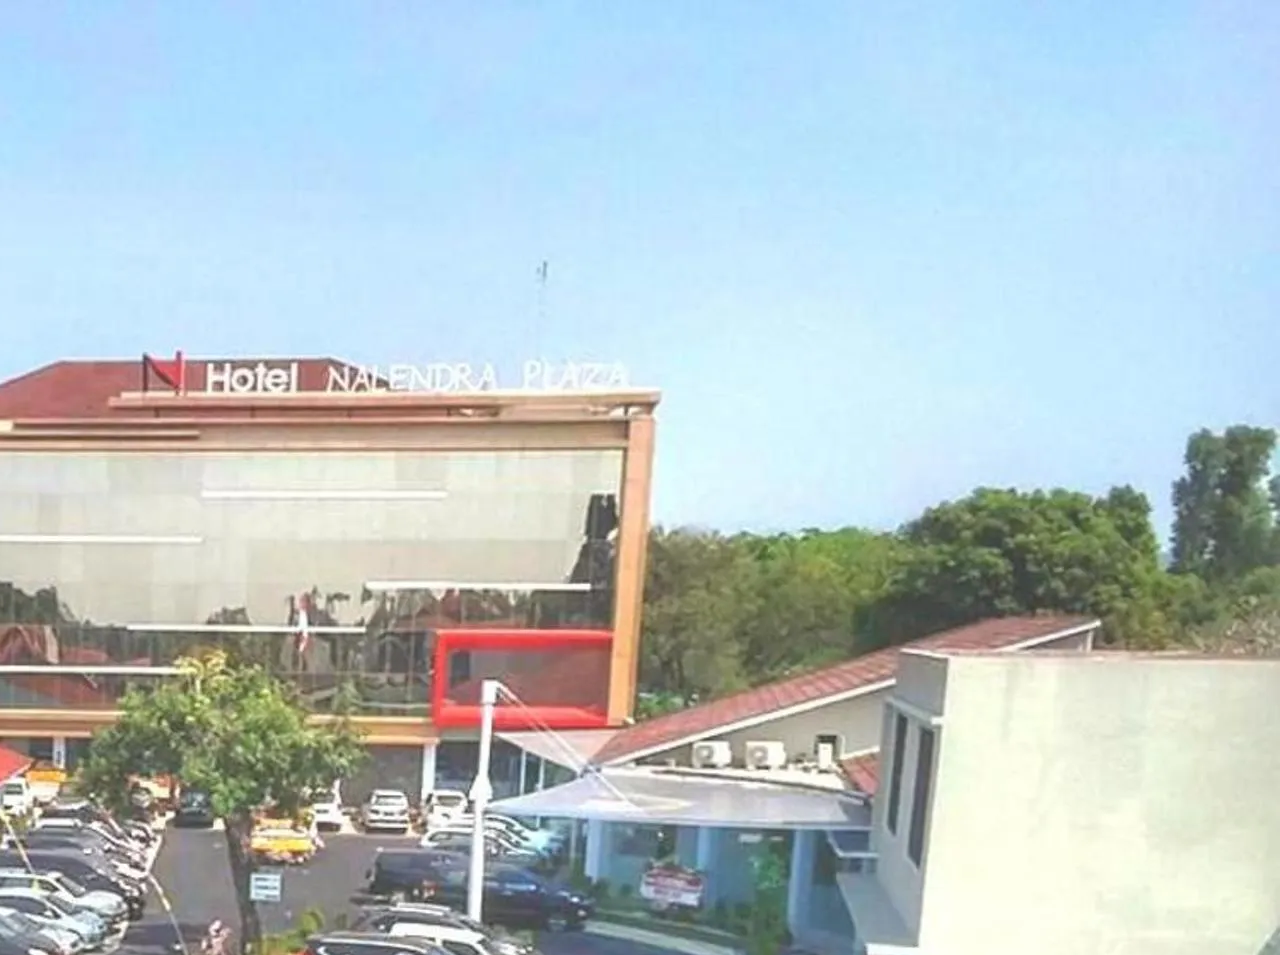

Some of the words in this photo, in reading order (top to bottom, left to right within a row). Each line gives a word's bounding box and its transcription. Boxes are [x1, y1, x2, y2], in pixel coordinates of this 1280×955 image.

[206, 362, 298, 393] Hotel
[326, 364, 498, 392] NALENDRA
[524, 358, 634, 388] PLAZA
